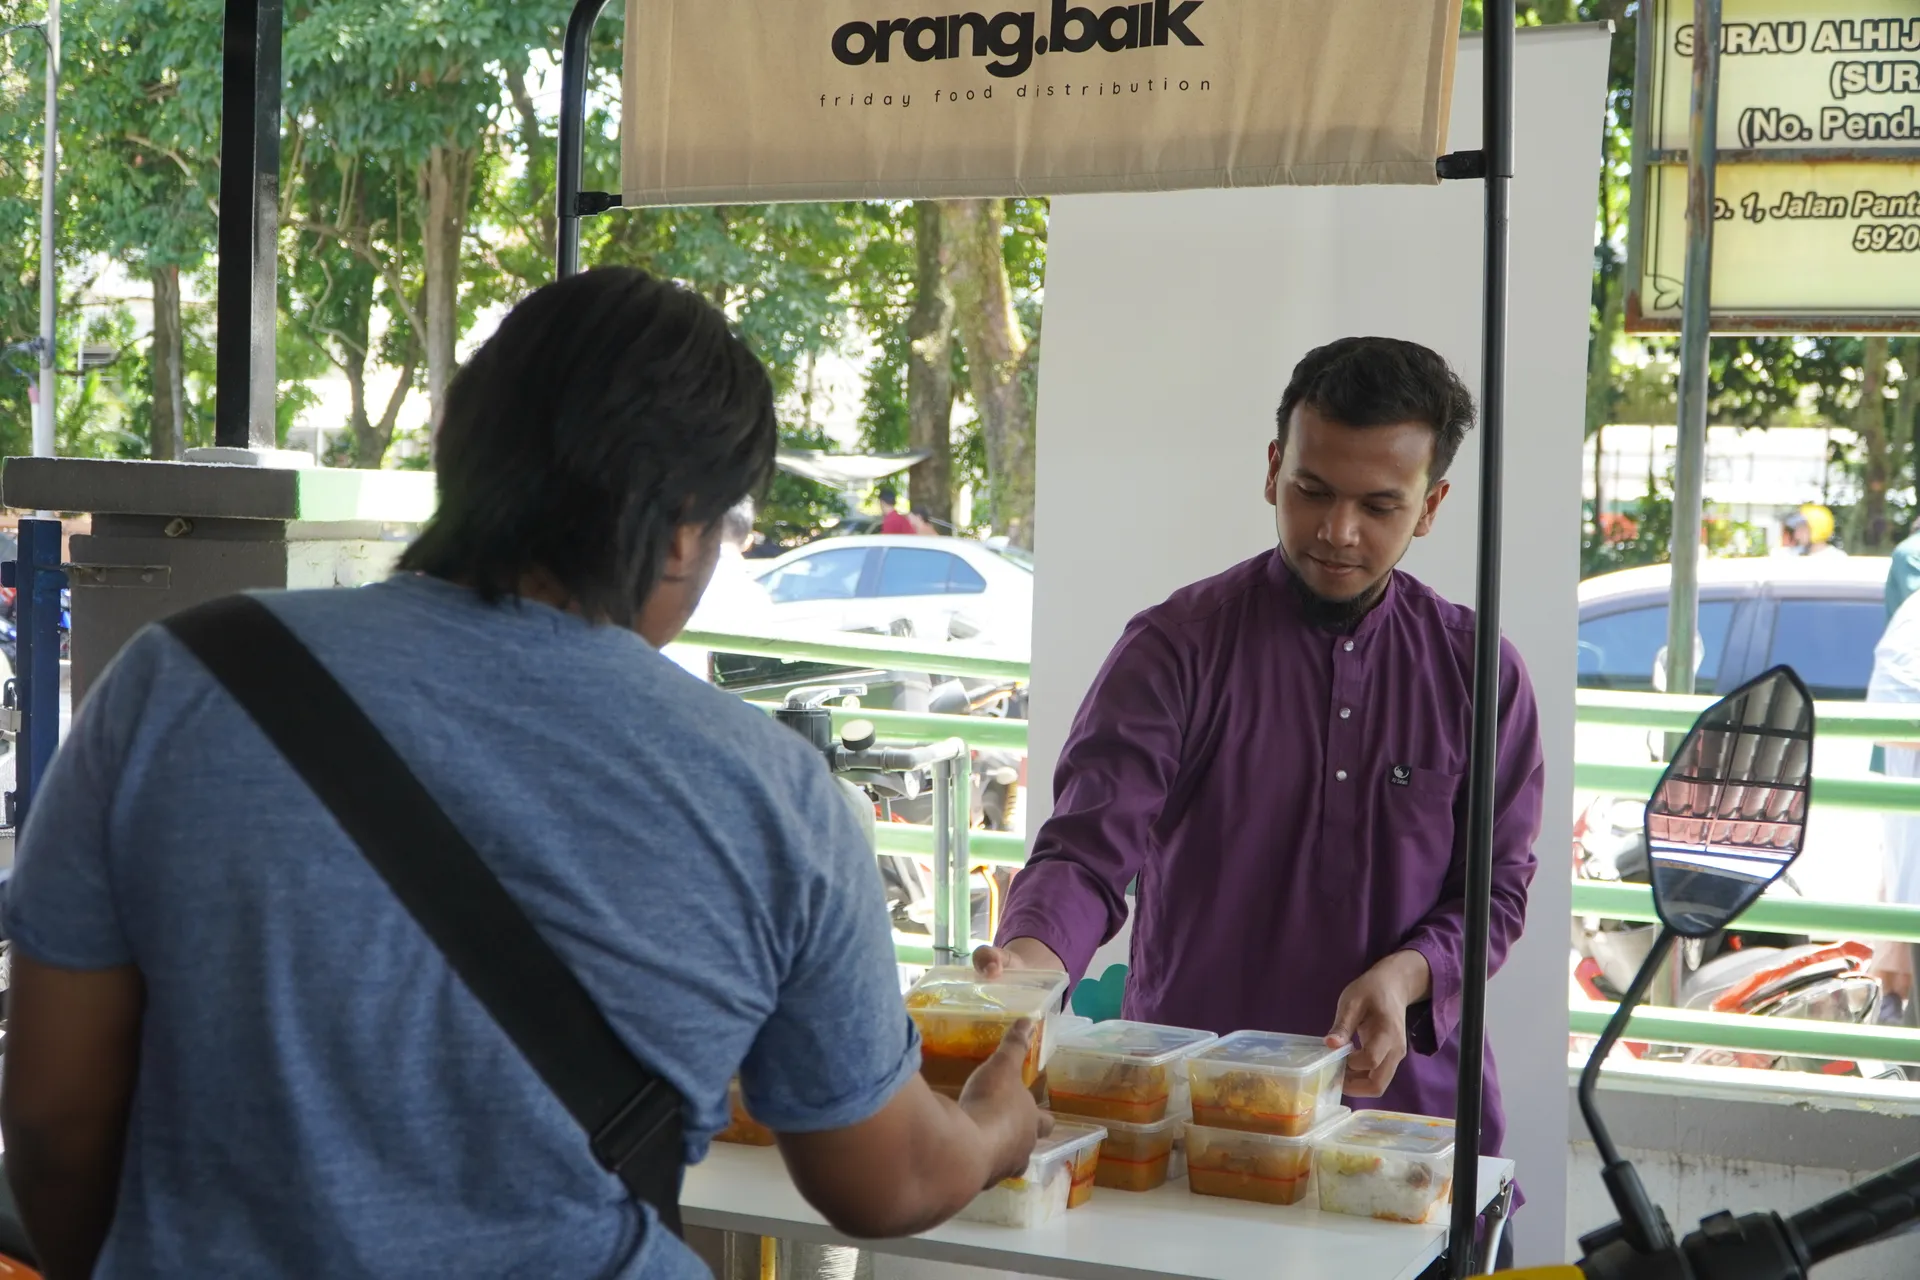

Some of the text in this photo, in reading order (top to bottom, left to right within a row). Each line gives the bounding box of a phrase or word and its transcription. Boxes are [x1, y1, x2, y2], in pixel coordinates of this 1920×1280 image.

[831, 0, 1205, 78] orang.baik
[1674, 21, 1806, 57] SRAU
[820, 77, 1211, 108] friday food distribution
[1829, 60, 1920, 100] (SUR
[1738, 107, 1813, 149] (No.
[1740, 191, 1767, 223] 1,
[1769, 191, 1849, 219] Jalan
[1852, 223, 1920, 252] 5920
